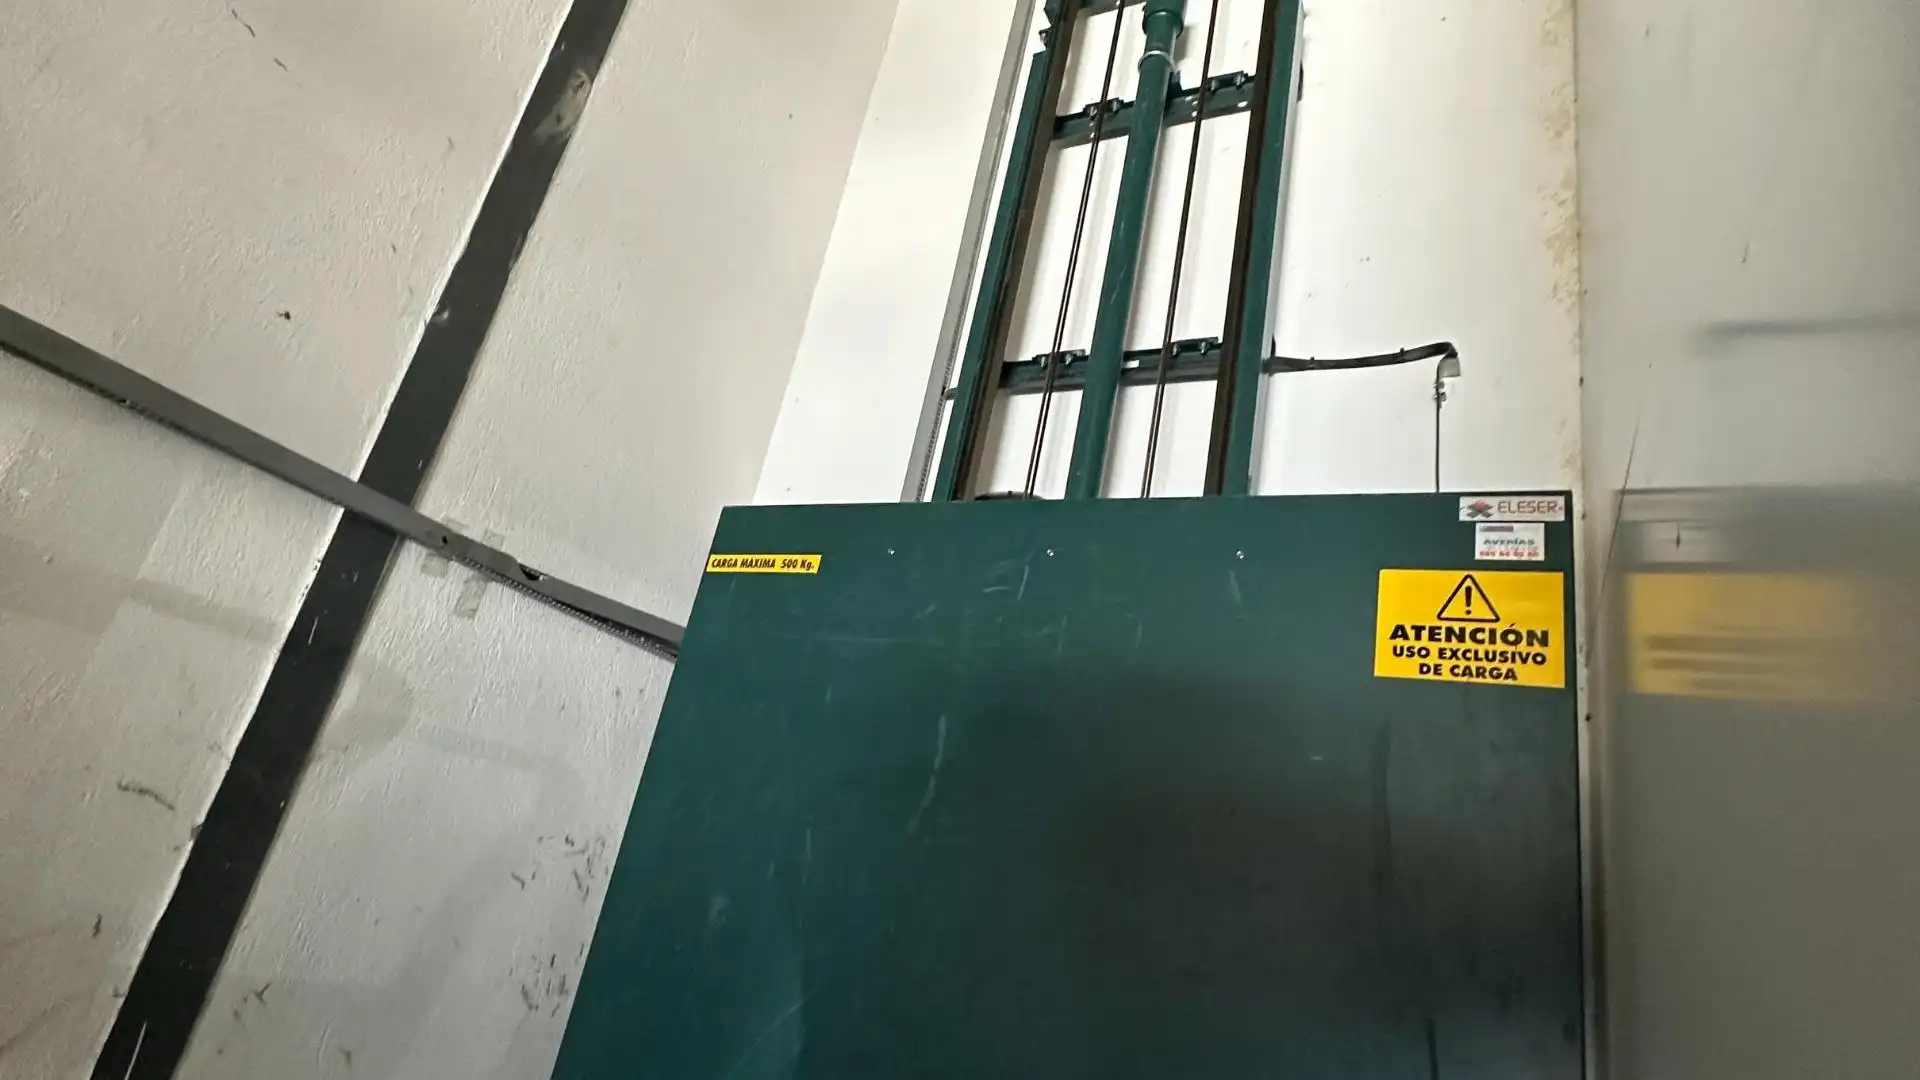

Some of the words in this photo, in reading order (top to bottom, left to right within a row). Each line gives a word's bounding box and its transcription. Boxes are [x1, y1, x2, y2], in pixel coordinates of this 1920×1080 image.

[1497, 500, 1558, 514] ELESER
[711, 558, 738, 568] CARGA
[781, 558, 798, 569] 500
[800, 559, 814, 571] Kg.
[1389, 622, 1549, 647] ATENCIÓN
[1392, 645, 1431, 659] USO
[1438, 647, 1547, 665] EXCLUSIVO
[1418, 662, 1443, 676] DE
[1449, 664, 1518, 681] CARGA
